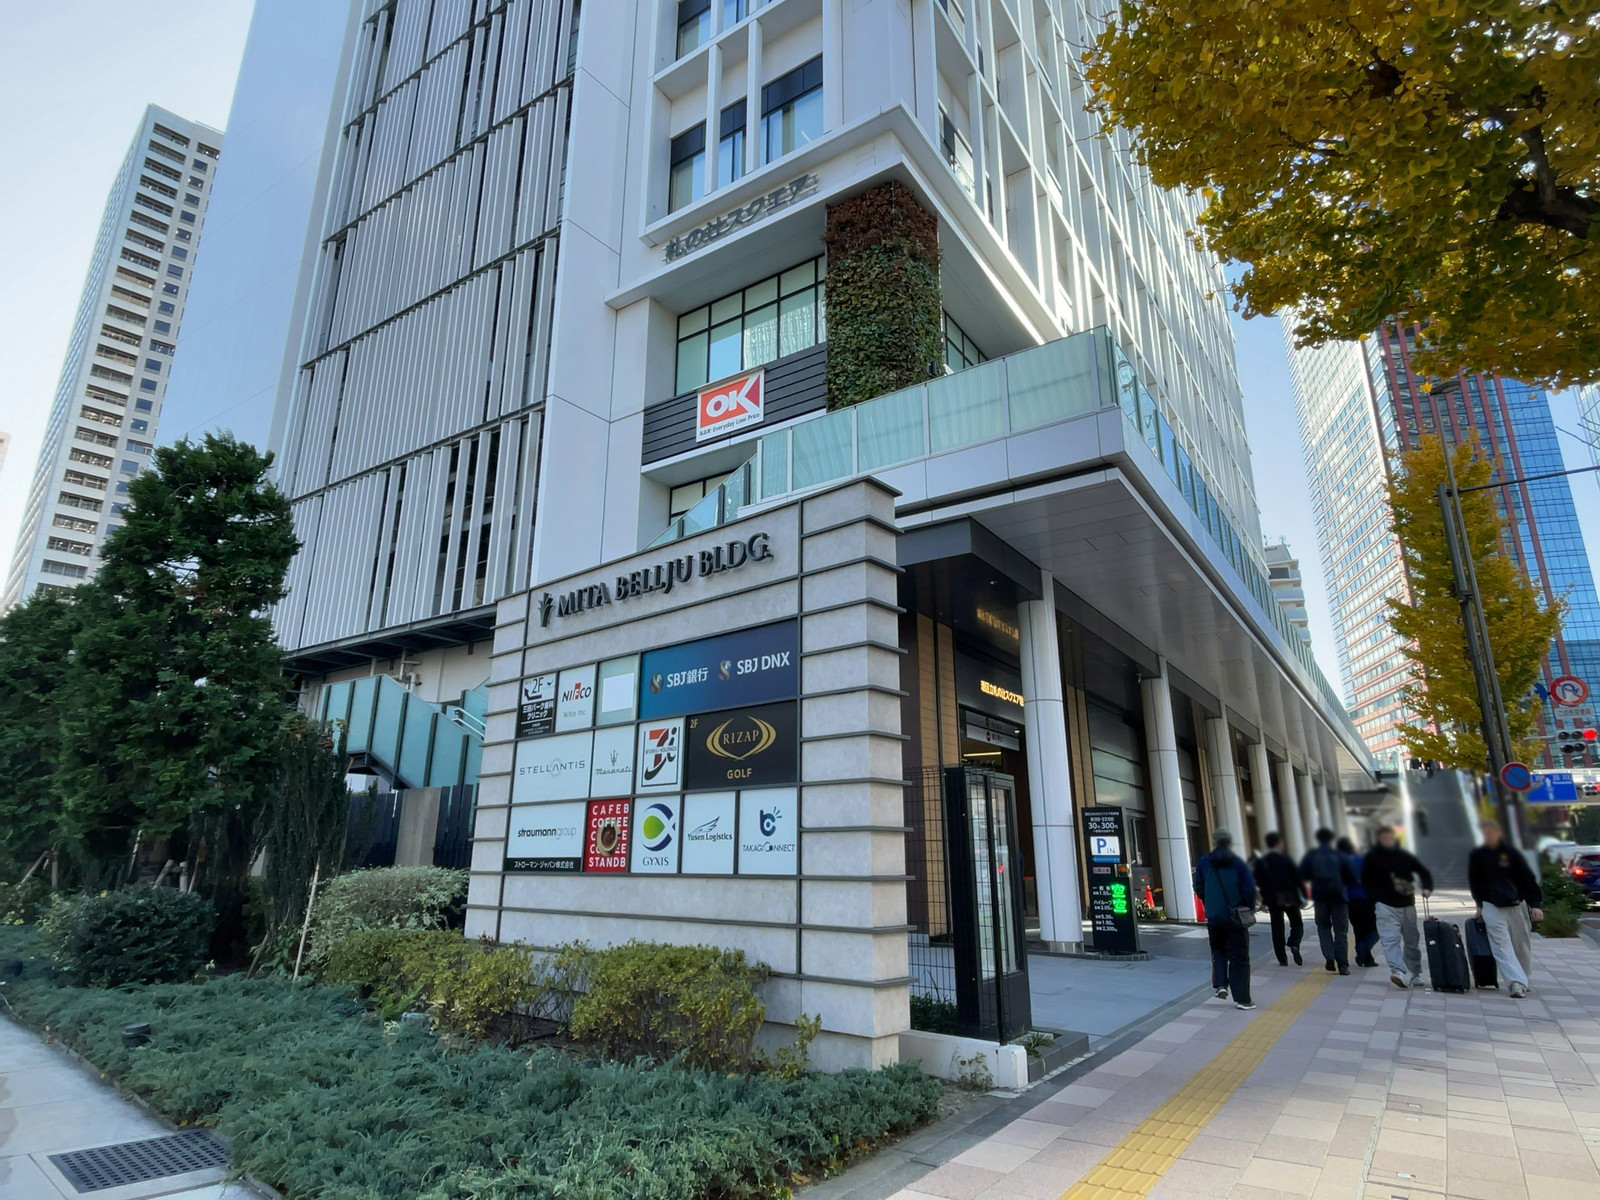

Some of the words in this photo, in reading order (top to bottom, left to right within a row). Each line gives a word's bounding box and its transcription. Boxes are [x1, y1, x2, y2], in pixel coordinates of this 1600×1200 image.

[663, 172, 818, 264] 札の辻スクエア
[706, 374, 760, 418] OK
[748, 413, 760, 421] Price
[556, 582, 612, 618] MITA
[614, 555, 695, 601] BELLJU
[737, 657, 758, 676] SBJ
[761, 651, 790, 671] DNX
[666, 667, 709, 688] SBJ銀行
[532, 677, 544, 694] 2F
[562, 684, 592, 702] NIFCO
[690, 718, 699, 729] 2F
[723, 730, 760, 745] RIZAP
[520, 760, 586, 775] STELLANTIS
[726, 768, 752, 779] GOLF
[591, 816, 628, 829] COFFEE
[687, 833, 705, 841] Yusen
[705, 832, 732, 842] Logistics
[1096, 838, 1107, 854] P
[642, 856, 669, 866] GYXIS
